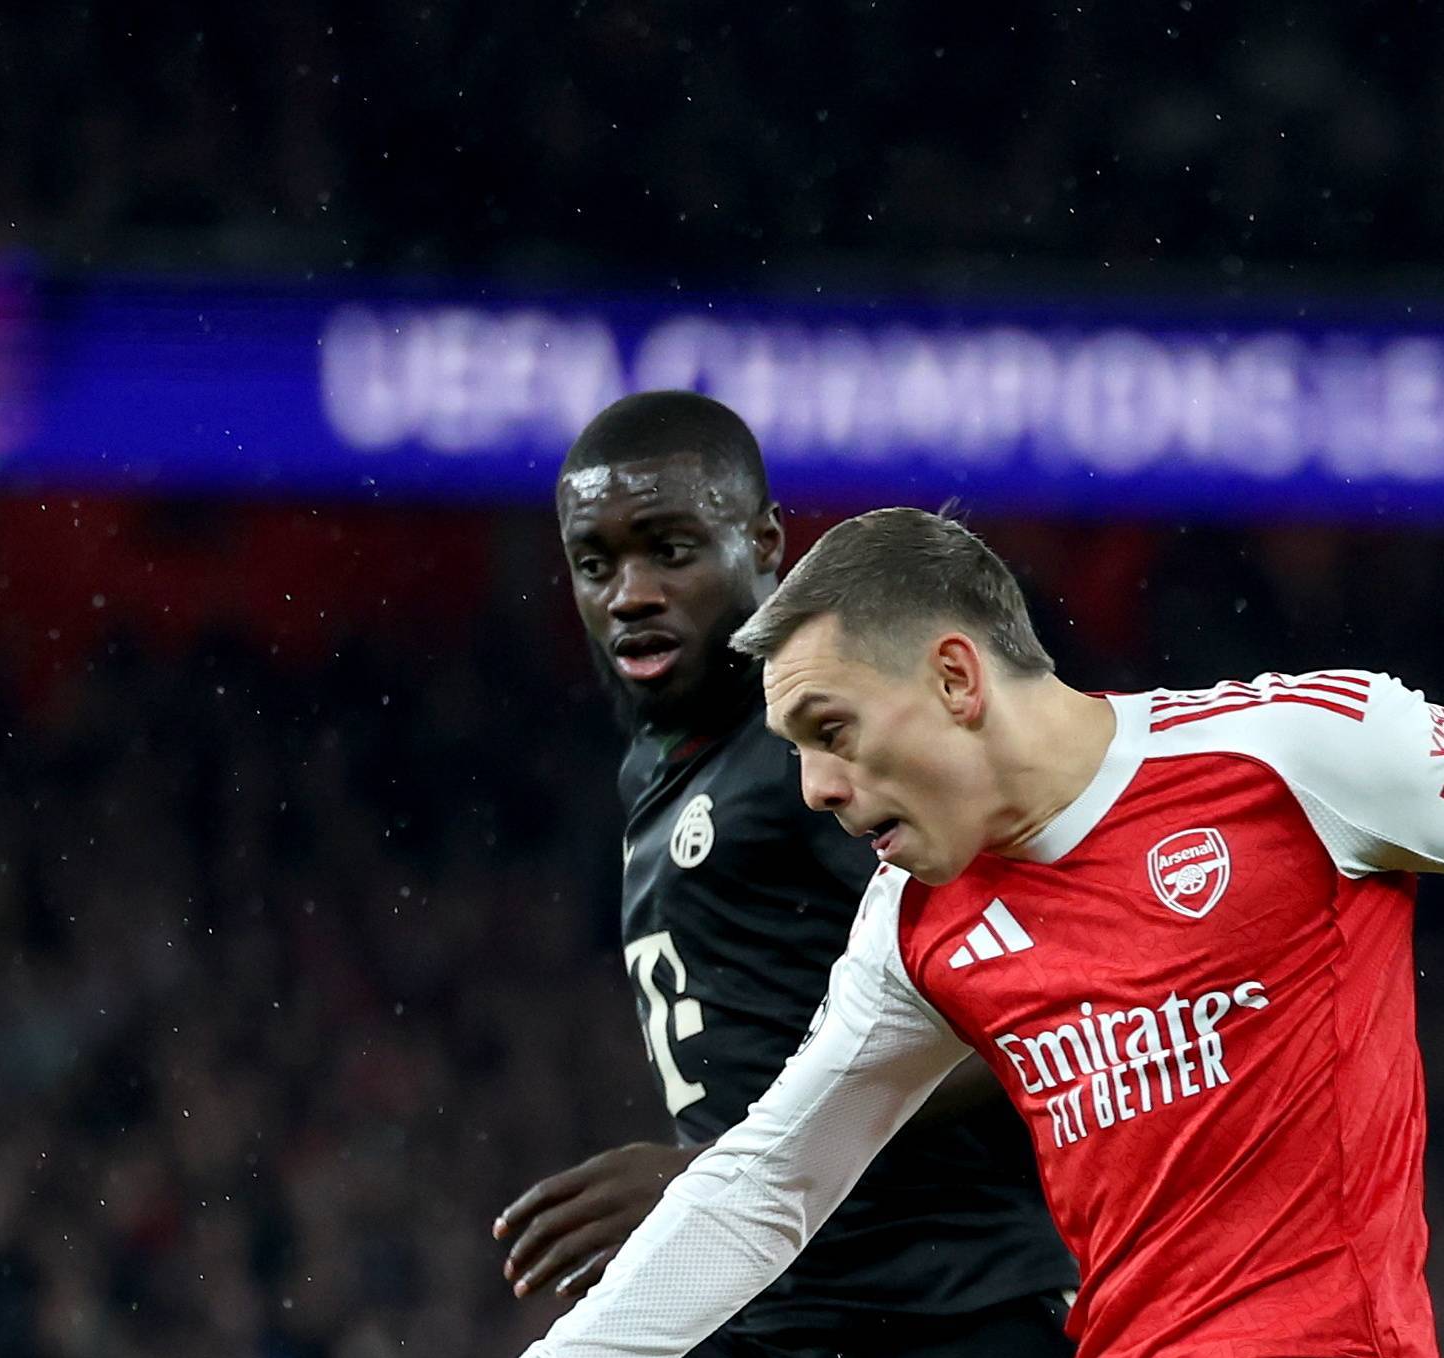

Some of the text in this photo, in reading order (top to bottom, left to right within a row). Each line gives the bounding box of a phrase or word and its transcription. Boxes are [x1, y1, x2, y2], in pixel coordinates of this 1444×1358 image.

[323, 304, 624, 450] UEFA
[632, 312, 1308, 476] CHAMPIONS
[1159, 840, 1214, 870] Arsenal
[995, 981, 1269, 1094] Emirates
[1046, 1031, 1231, 1148] FLY BETTER
